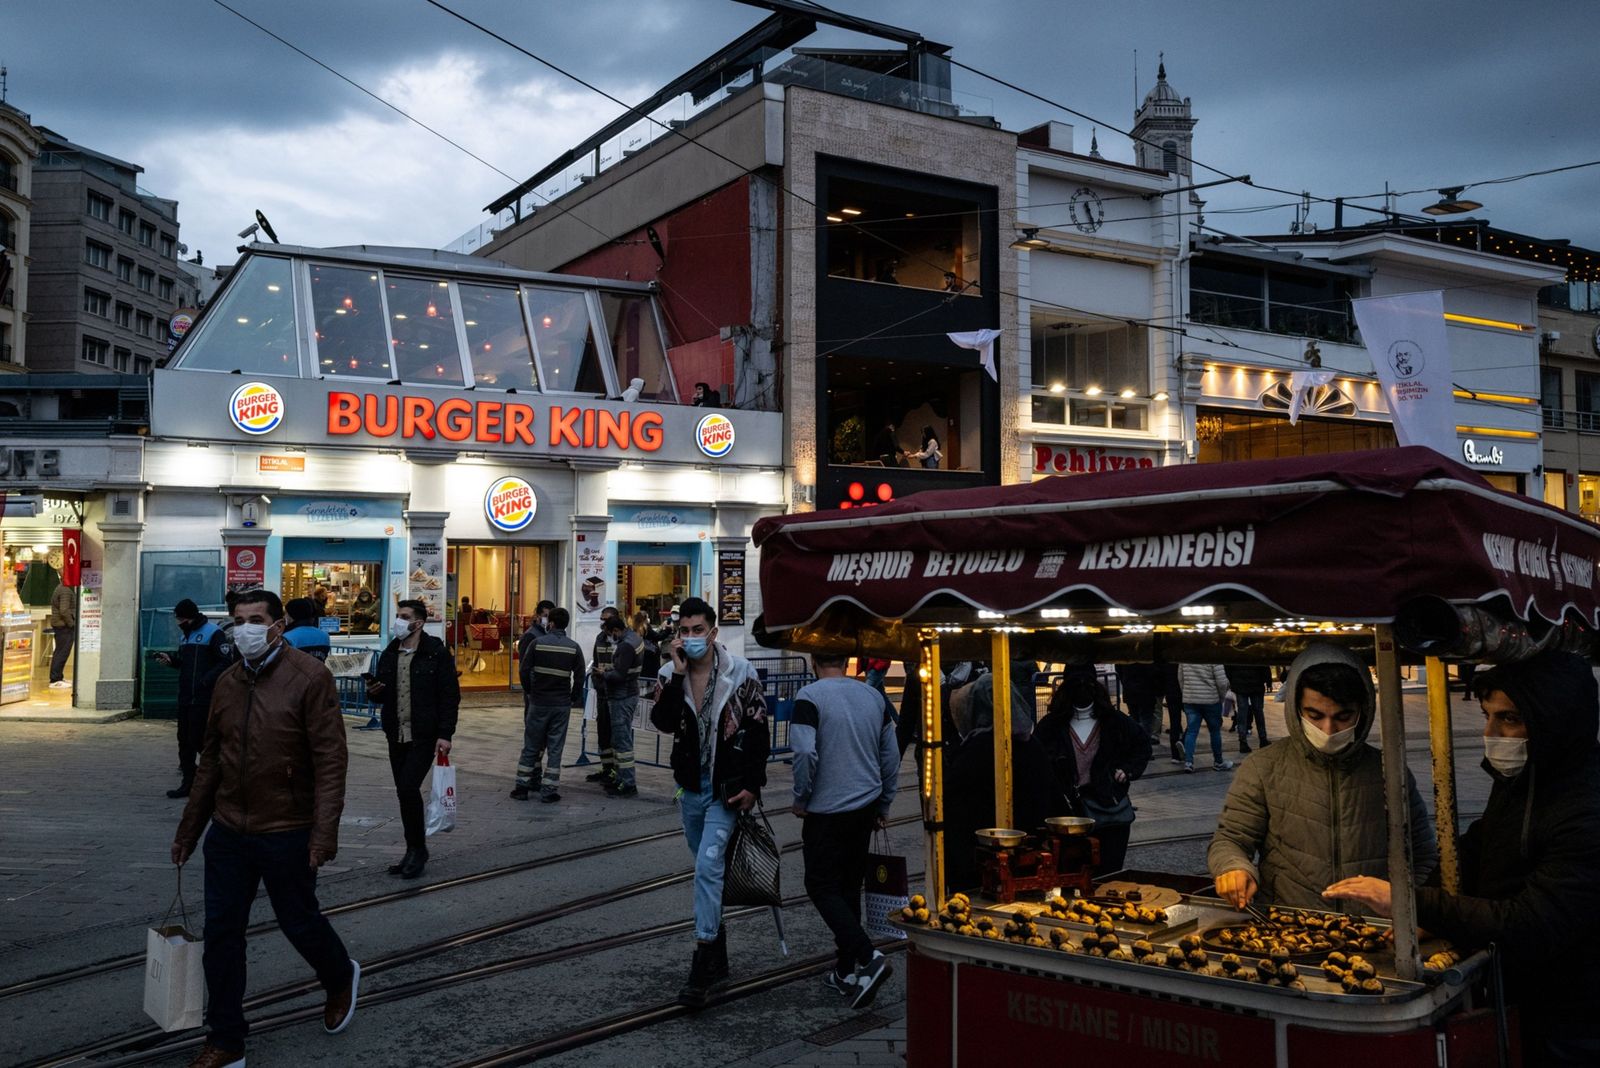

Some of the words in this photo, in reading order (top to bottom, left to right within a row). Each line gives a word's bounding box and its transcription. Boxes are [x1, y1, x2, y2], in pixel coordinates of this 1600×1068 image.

[237, 393, 277, 409] BURGER
[239, 402, 278, 422] KING
[327, 391, 535, 445] BURGER
[549, 406, 664, 451] KING
[702, 422, 730, 436] BURGER
[703, 430, 732, 446] KING
[1035, 447, 1153, 473] Pehlivan
[1463, 439, 1503, 465] Bambi
[492, 487, 530, 507] BURGER
[495, 496, 531, 518] KING
[826, 551, 914, 586] MEŞHUR
[1078, 524, 1256, 571] KESTANECİSİ
[1009, 991, 1119, 1041] KESTANE
